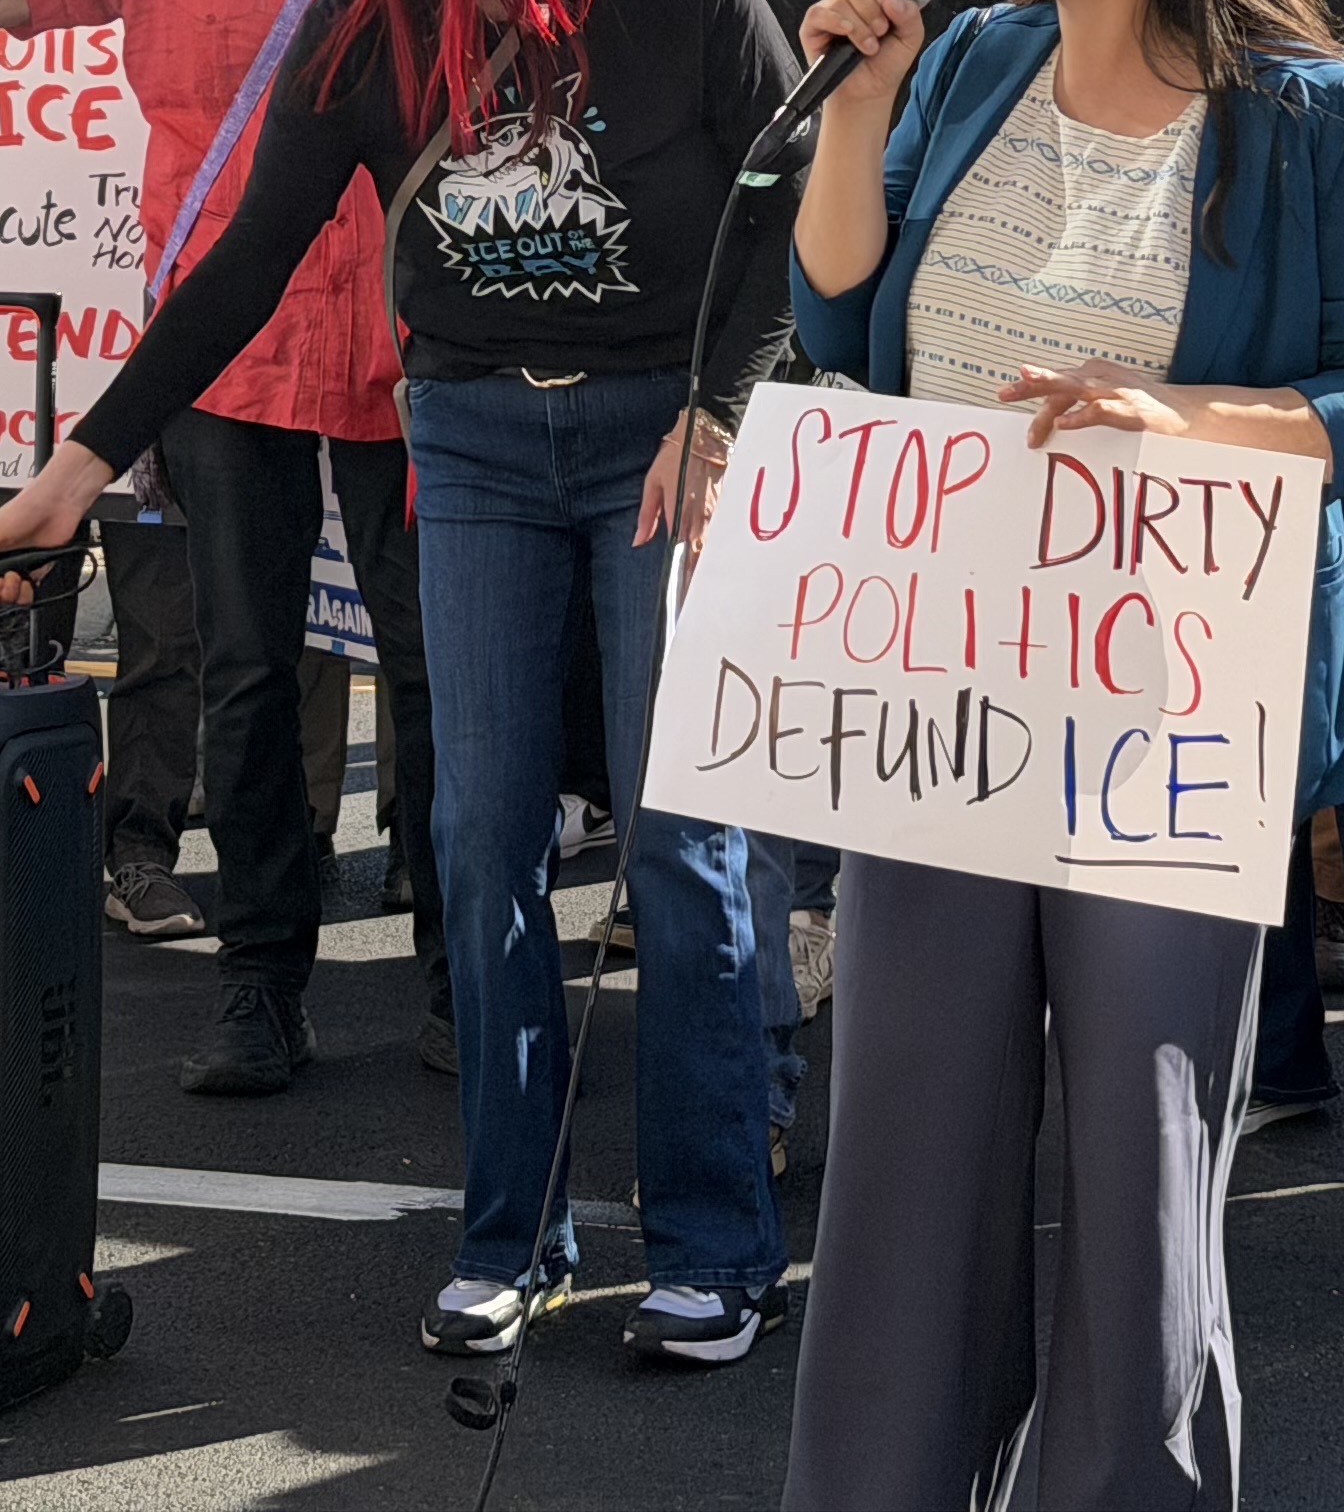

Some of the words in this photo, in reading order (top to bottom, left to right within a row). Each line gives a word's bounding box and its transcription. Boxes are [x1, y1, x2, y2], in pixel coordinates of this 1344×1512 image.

[461, 239, 515, 262] ICE
[516, 232, 564, 256] OUT
[749, 408, 991, 553] STOP
[1030, 451, 1283, 600] DIRTY
[695, 656, 1032, 810] DEFUND
